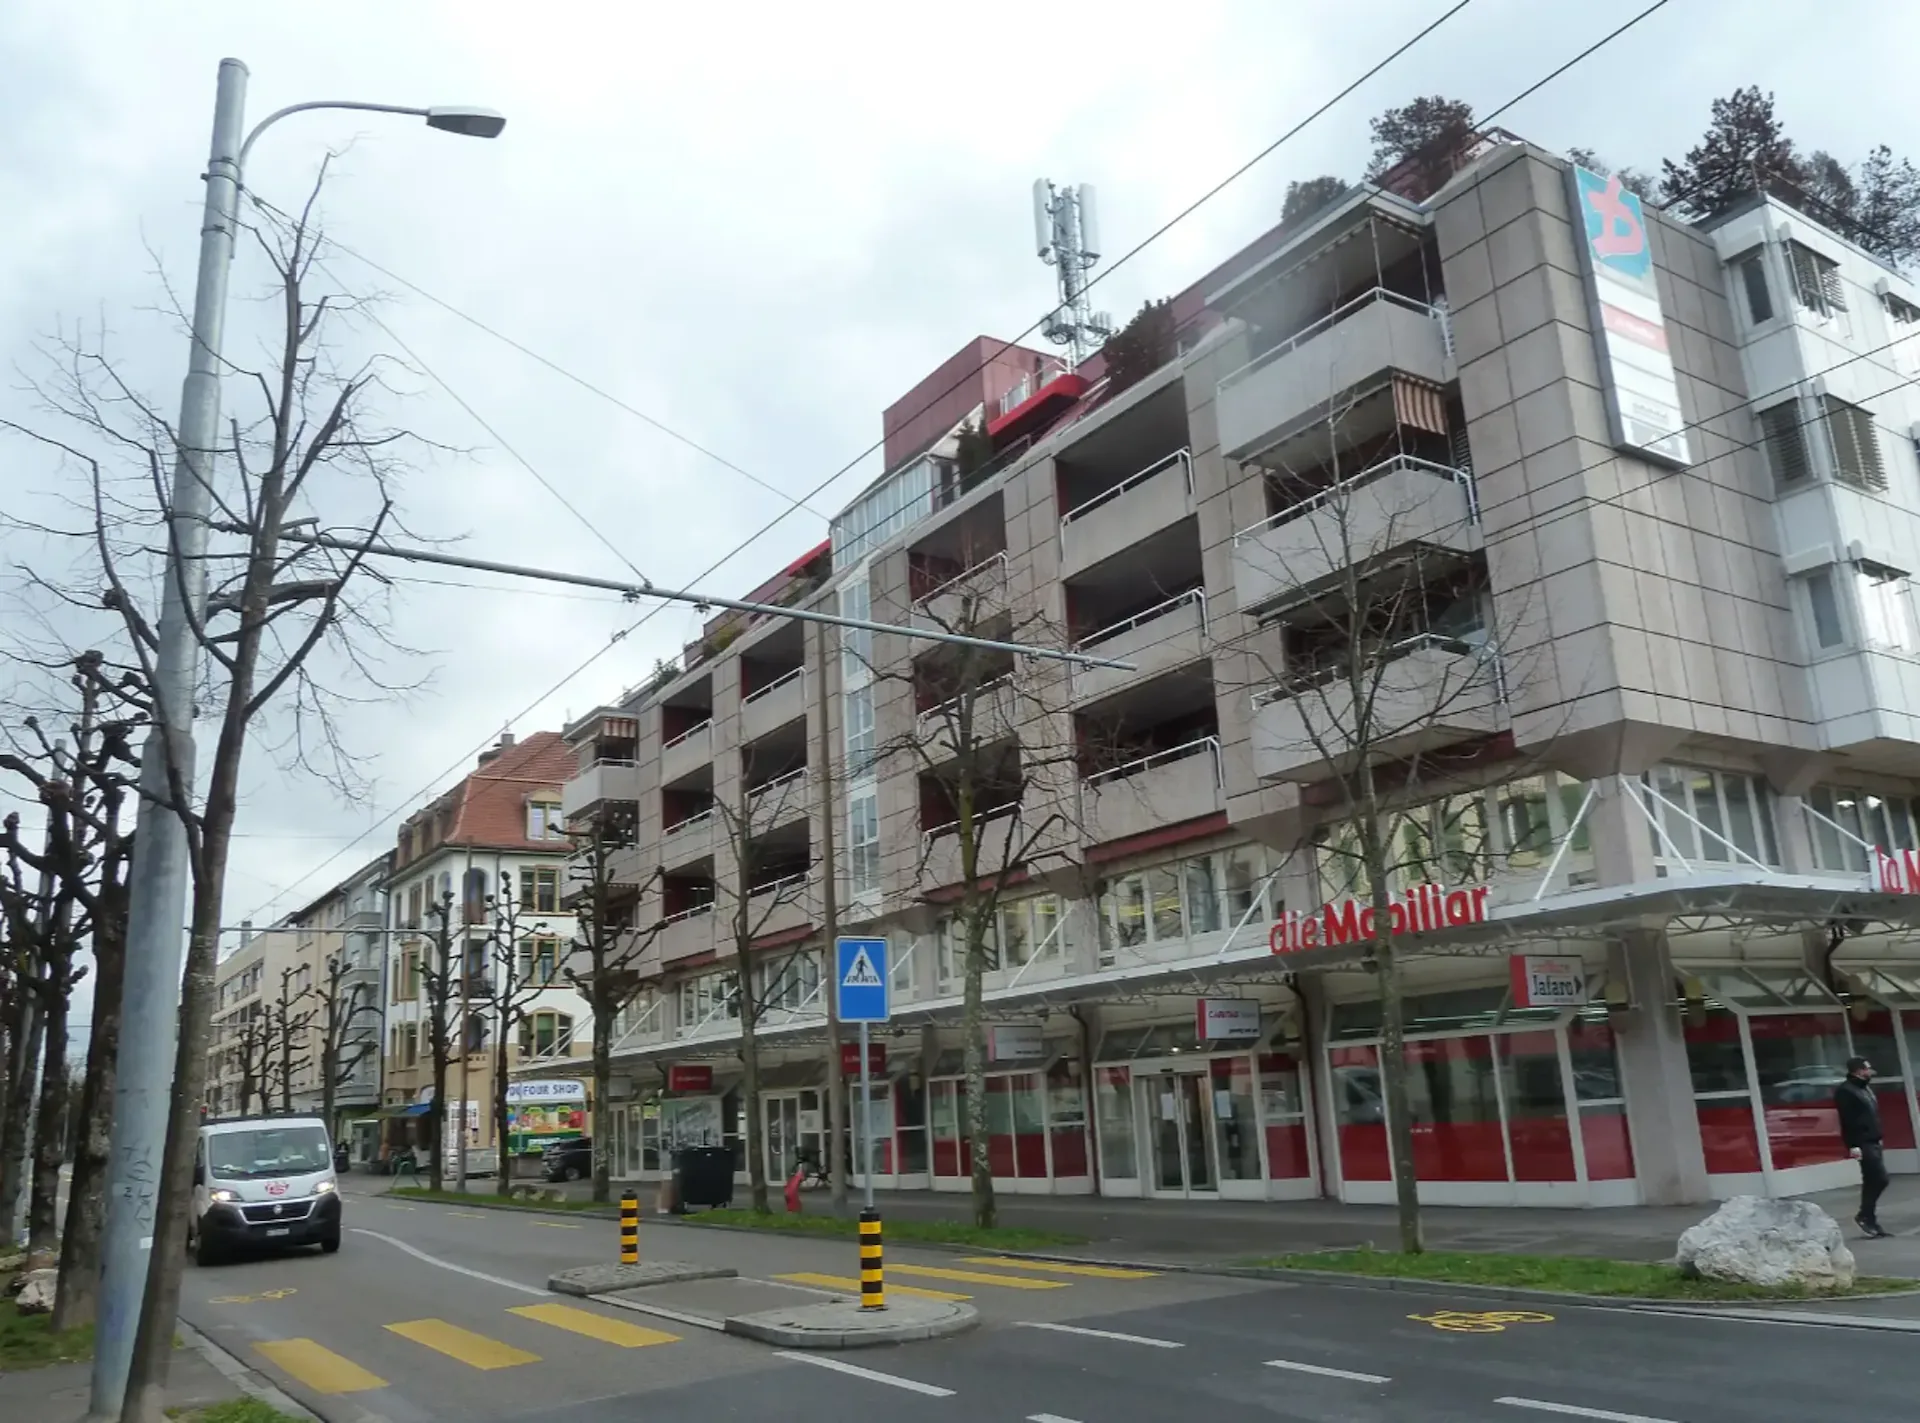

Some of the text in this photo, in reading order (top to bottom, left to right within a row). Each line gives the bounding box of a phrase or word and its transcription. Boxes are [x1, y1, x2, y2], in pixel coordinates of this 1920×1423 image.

[1269, 883, 1490, 955] die Mobiliar
[523, 1085, 550, 1096] FOUR
[552, 1084, 579, 1095] SHOP
